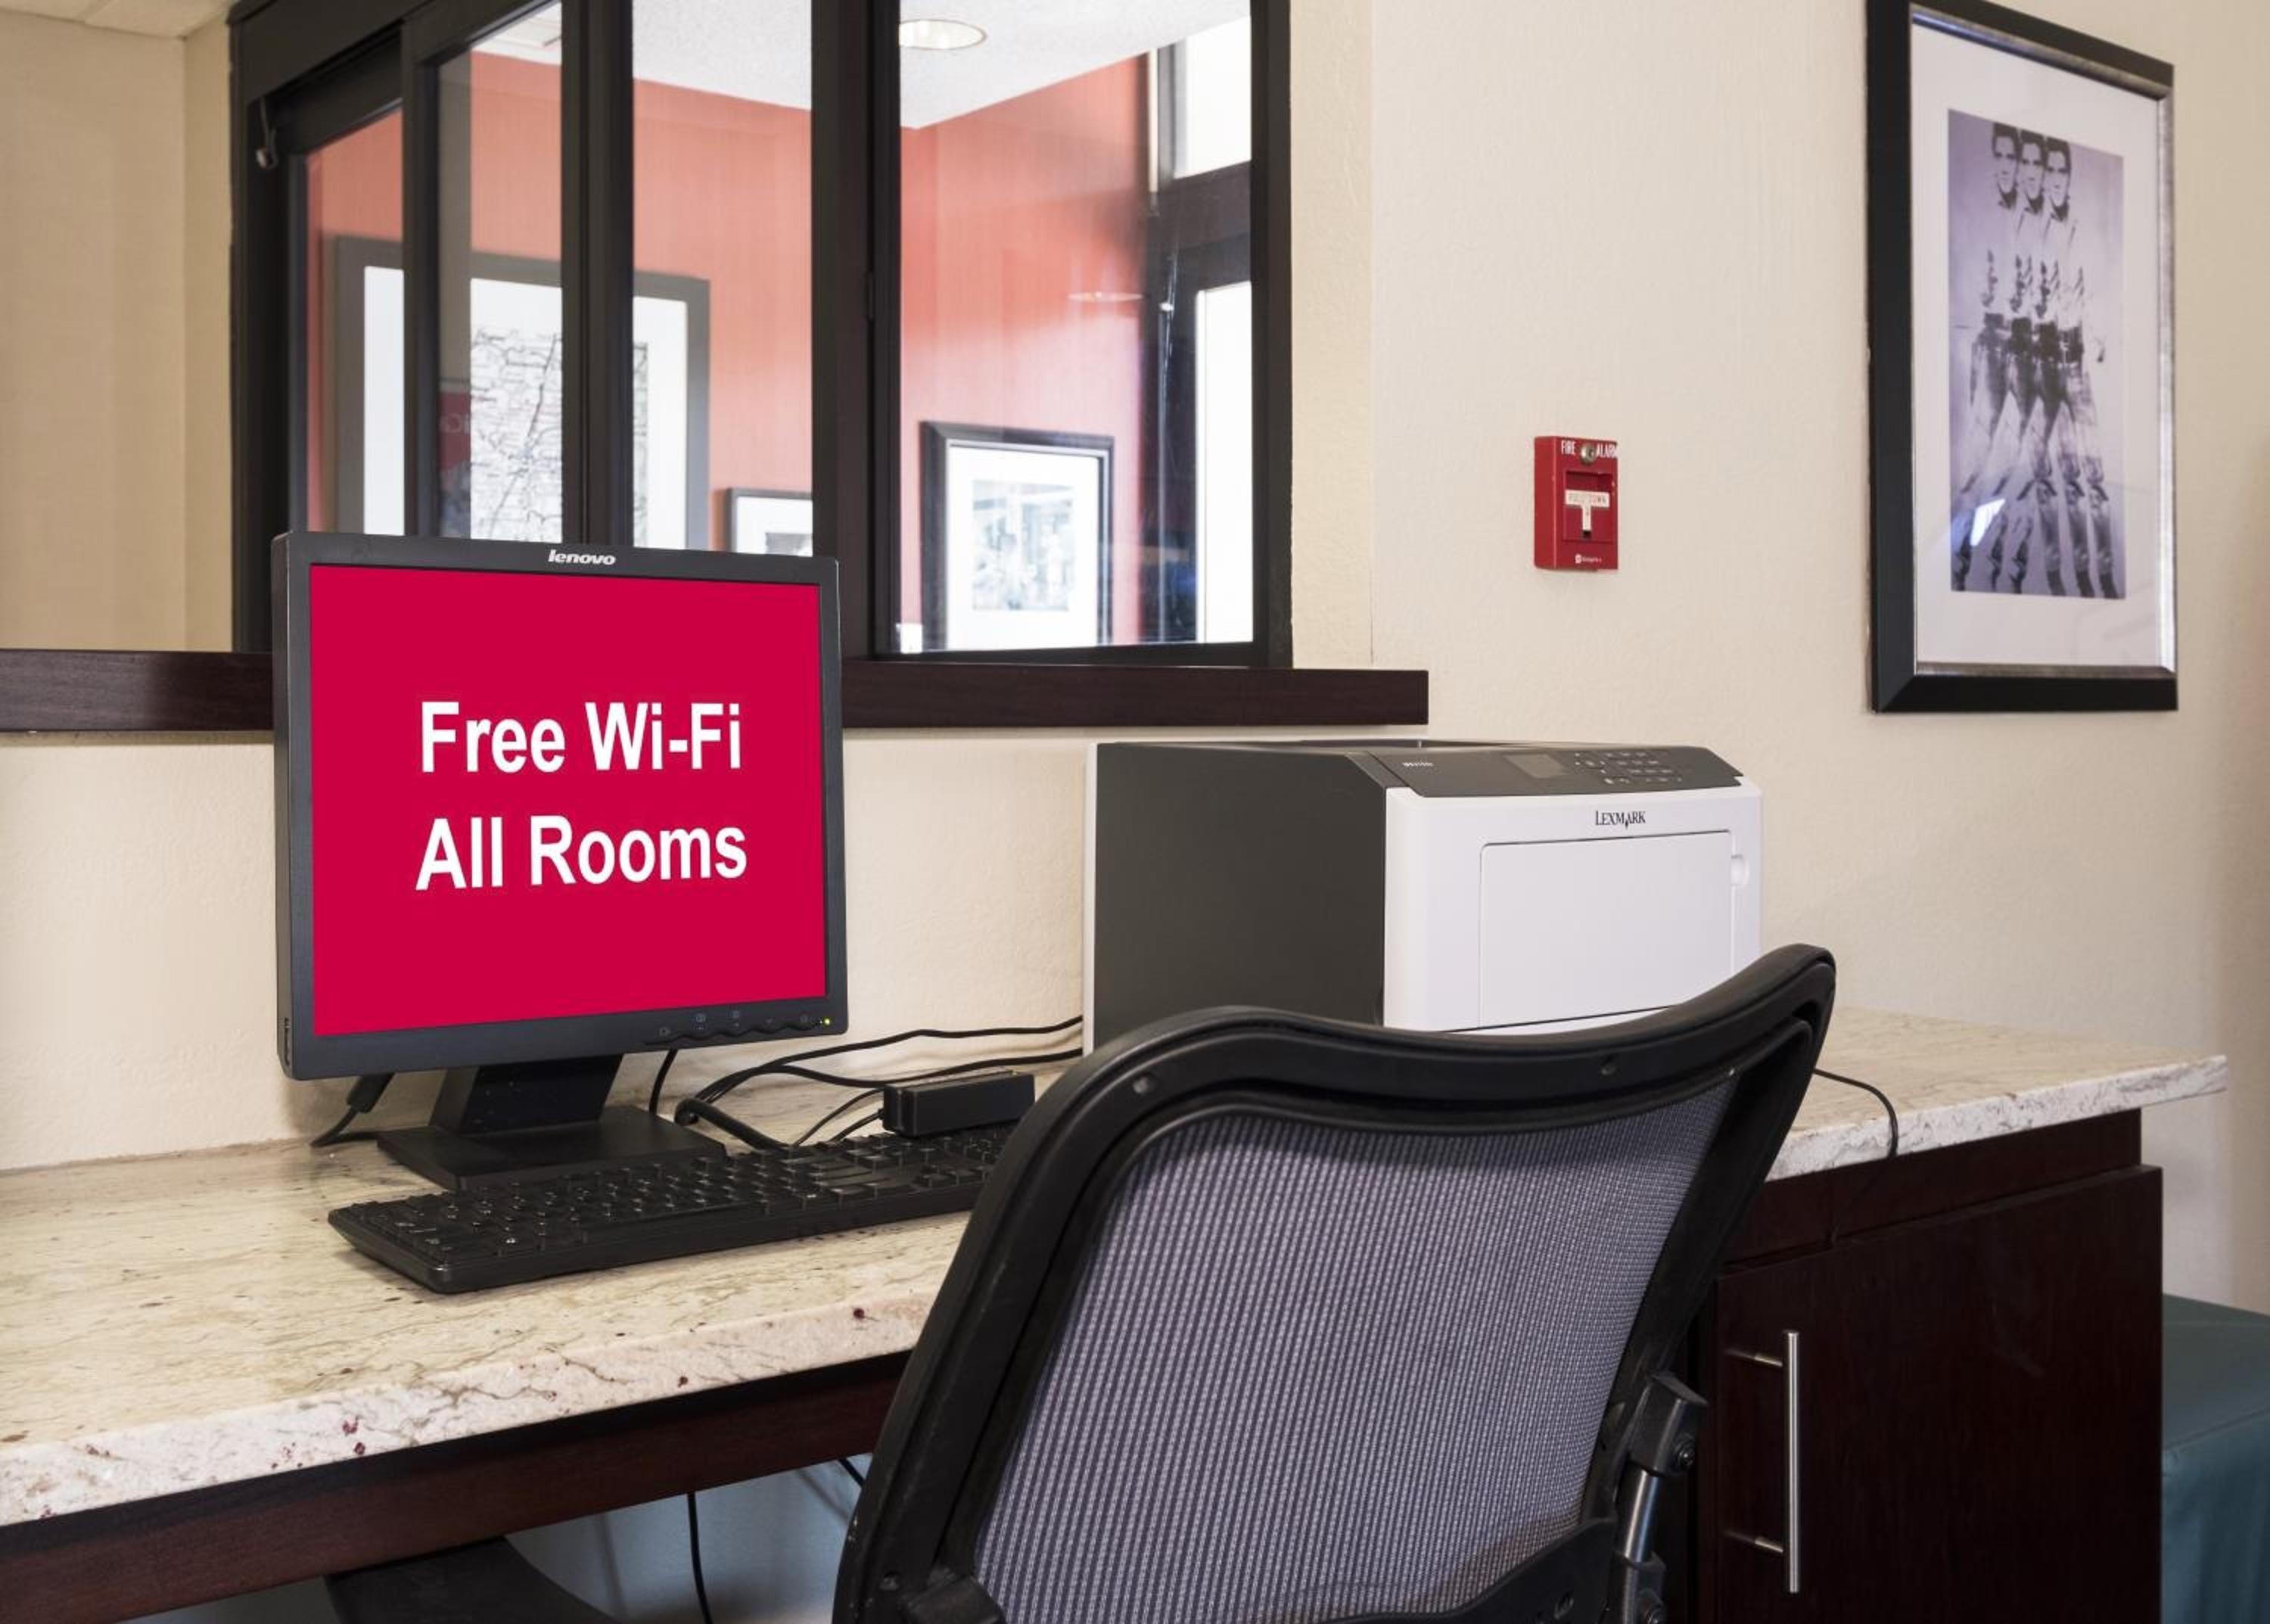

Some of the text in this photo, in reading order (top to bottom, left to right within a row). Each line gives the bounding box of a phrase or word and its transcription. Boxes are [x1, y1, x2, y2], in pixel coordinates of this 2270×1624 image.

[1561, 440, 1575, 455] FIRE
[548, 549, 617, 565] lenovo
[421, 701, 742, 773] Free Wi-Fi
[1594, 810, 1647, 829] LEXMARK
[415, 815, 748, 891] All Rooms
